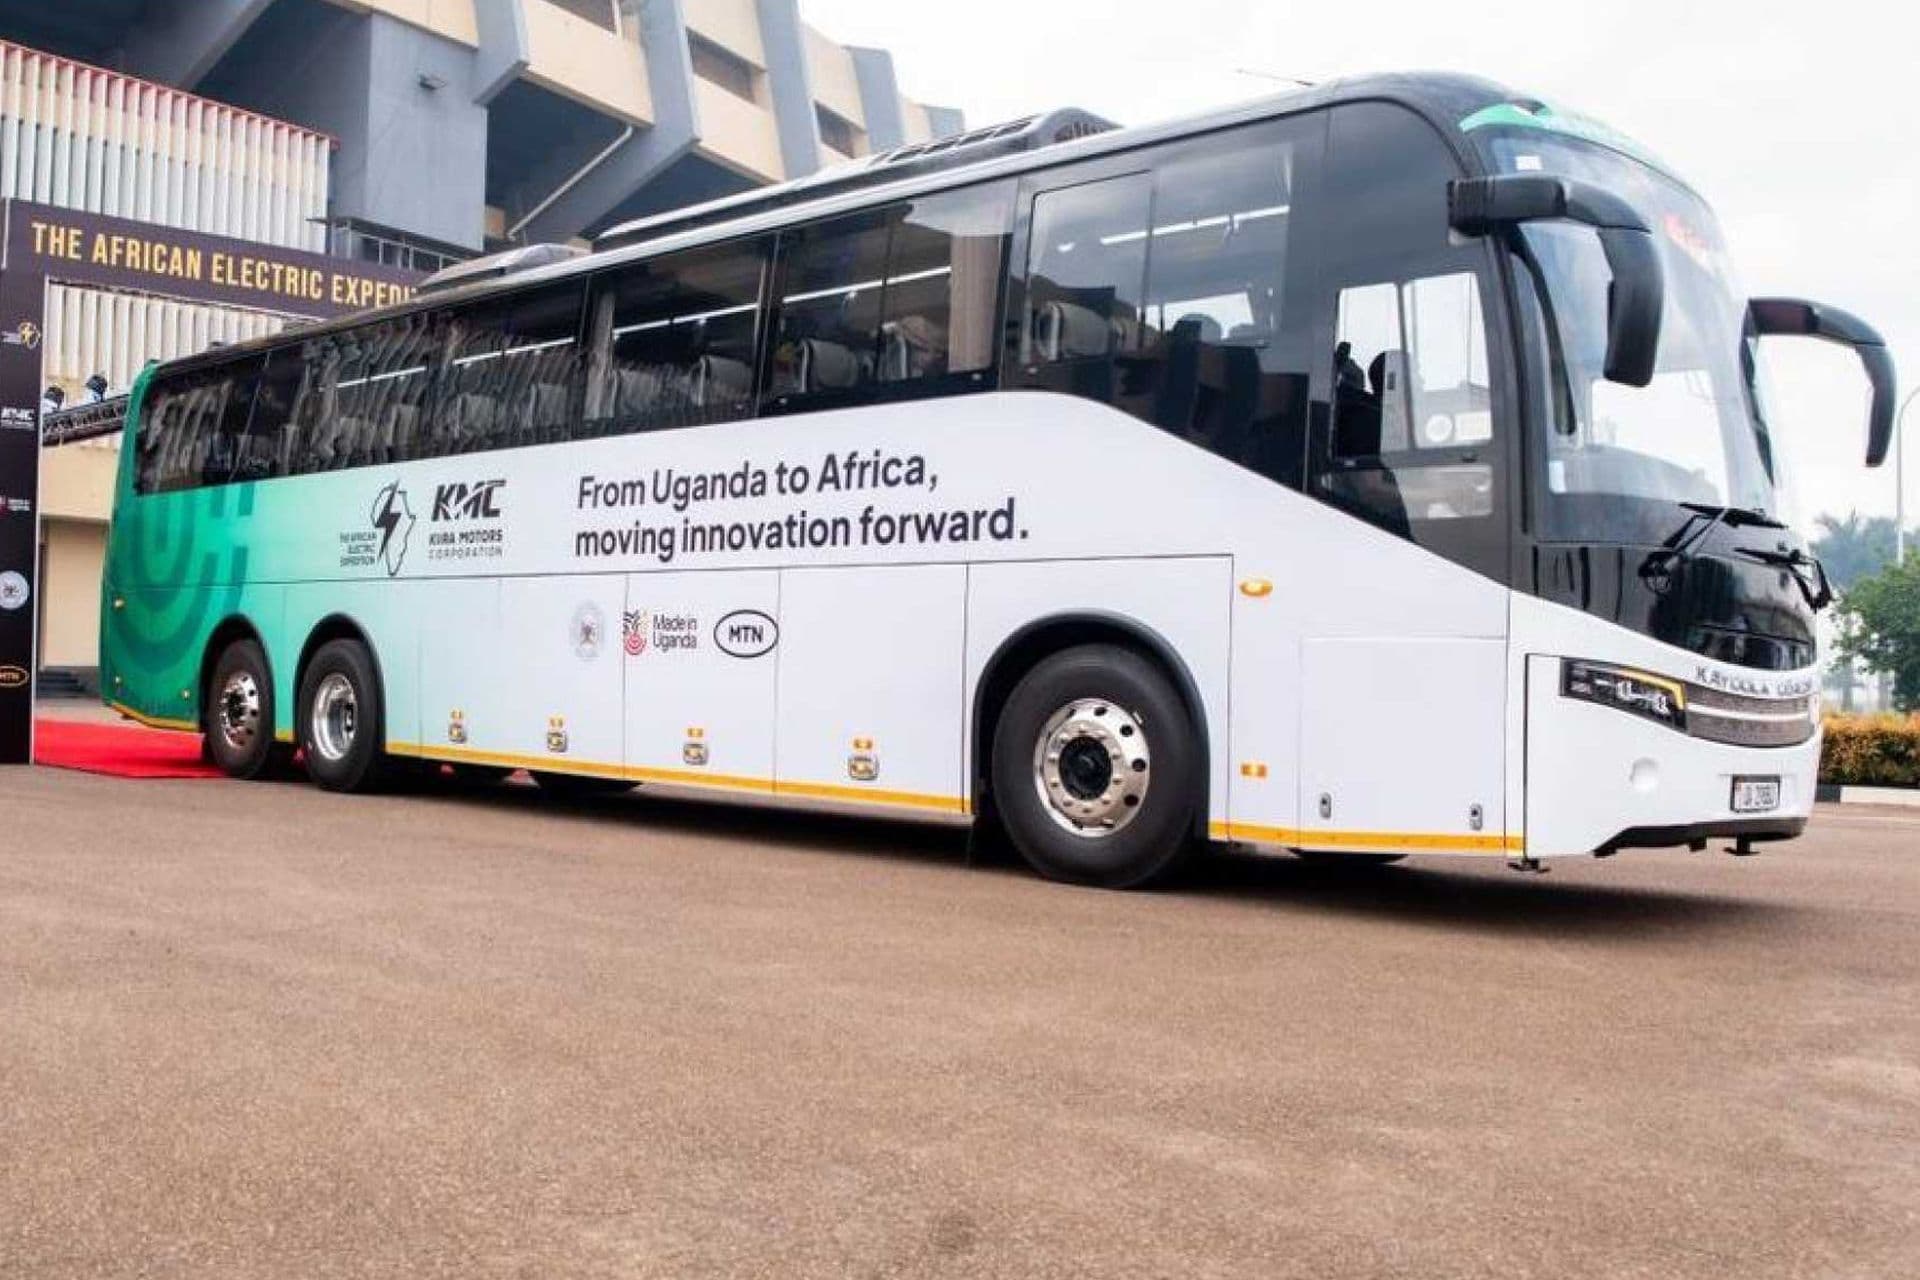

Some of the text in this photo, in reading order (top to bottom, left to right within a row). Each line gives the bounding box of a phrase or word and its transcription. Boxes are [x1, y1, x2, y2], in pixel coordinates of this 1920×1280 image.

[32, 222, 417, 309] THE AFRICAN ELECTRIC EXPEDI
[431, 479, 506, 522] KMC
[578, 449, 938, 512] From Uganda to Africa,
[575, 497, 1029, 562] moving innovation forward.
[653, 615, 697, 630] Made in
[653, 632, 697, 652] Uganda
[729, 625, 763, 643] MTN
